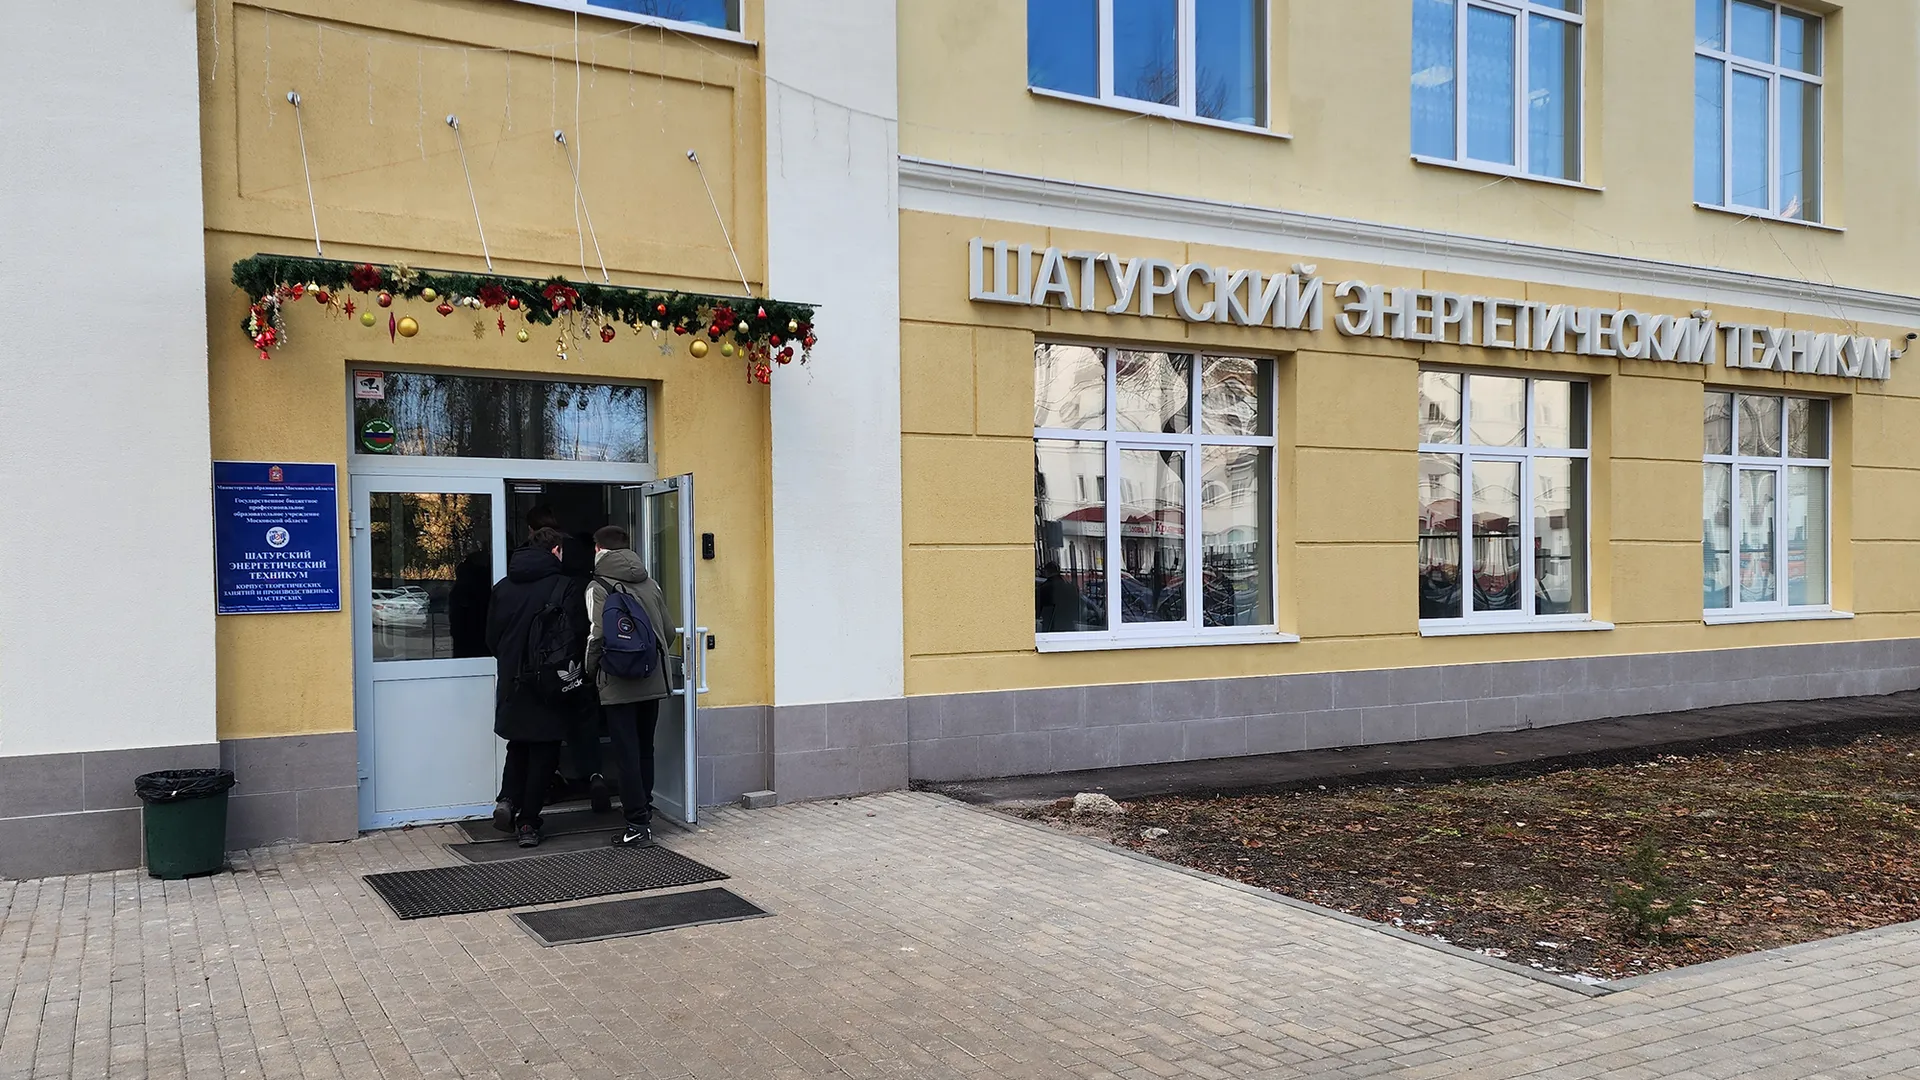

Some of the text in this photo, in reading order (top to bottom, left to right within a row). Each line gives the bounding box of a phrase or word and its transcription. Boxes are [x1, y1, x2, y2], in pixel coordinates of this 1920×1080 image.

[968, 236, 1893, 381] ШАТУРСКИЙ ЭНЕРГЕТИЧЕСКИЙ ТЕХНИКУМ
[244, 549, 312, 560] ШАТУРСКИЙ
[228, 560, 327, 570] ЭНЕРГЕТИЧЕСКИЙ
[248, 571, 309, 580] ТЕХНИКУМ
